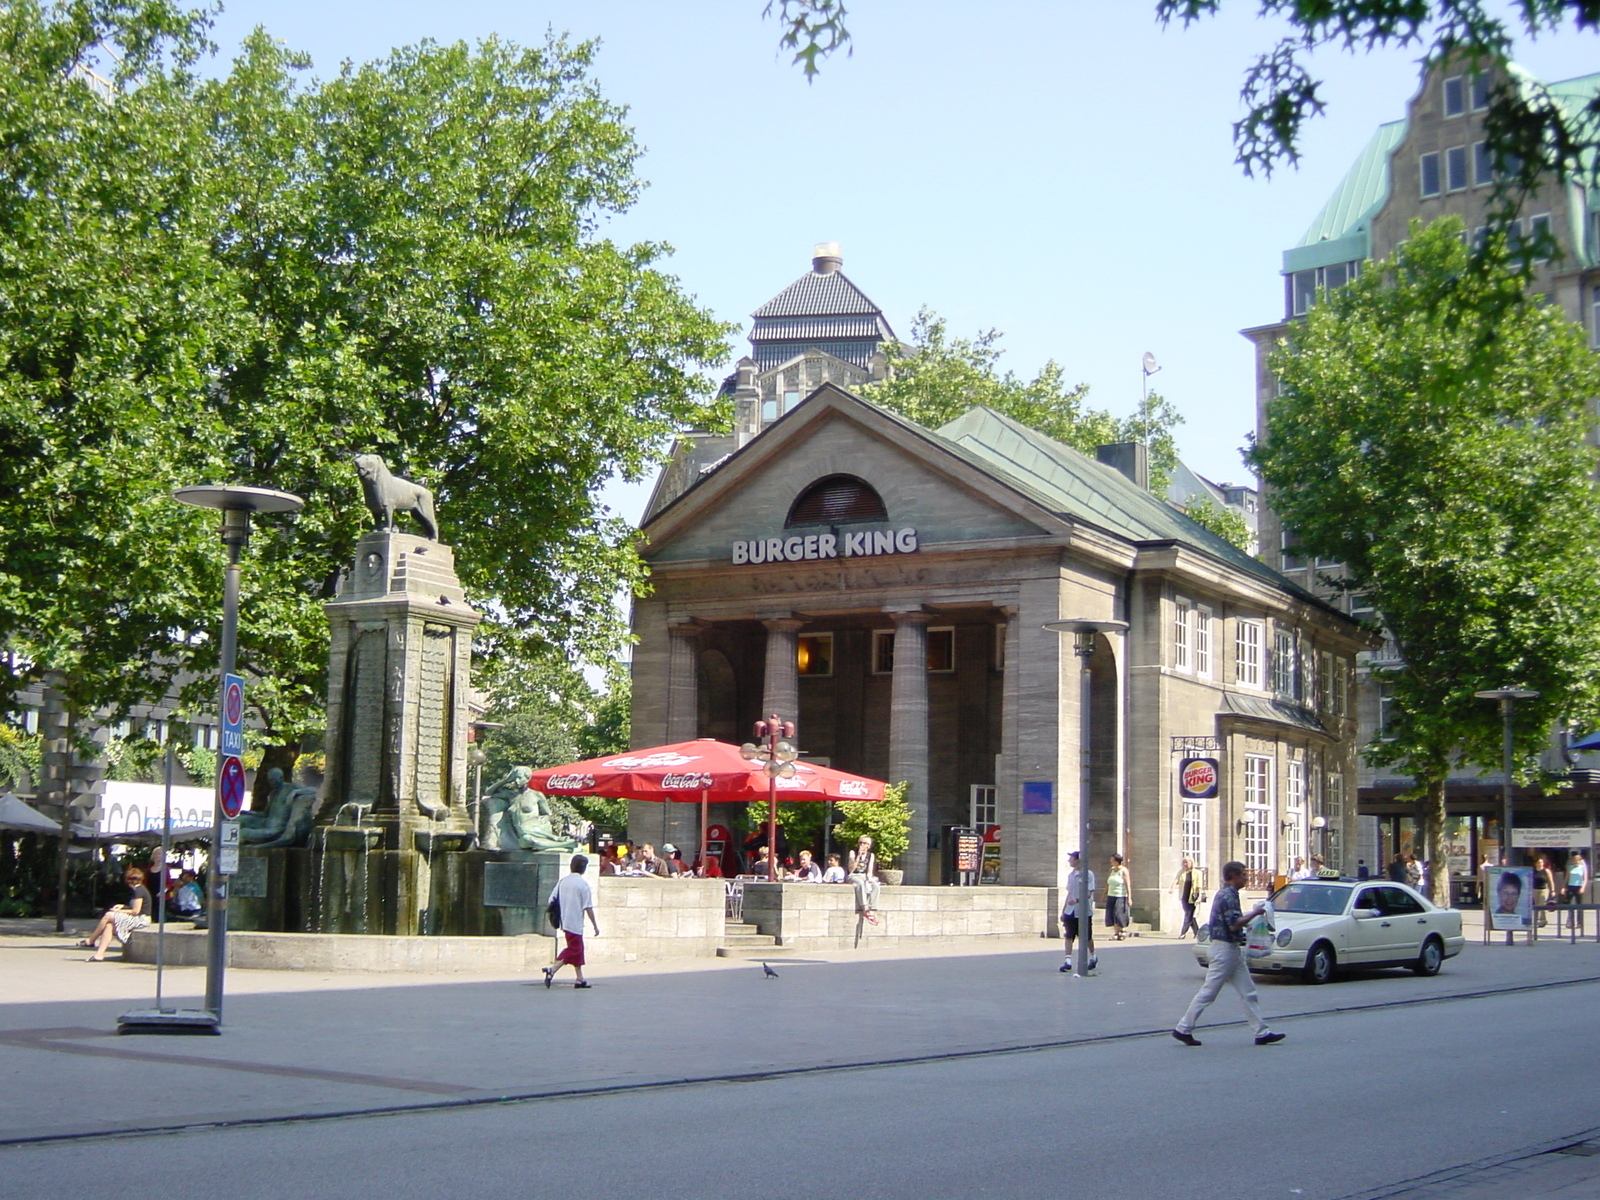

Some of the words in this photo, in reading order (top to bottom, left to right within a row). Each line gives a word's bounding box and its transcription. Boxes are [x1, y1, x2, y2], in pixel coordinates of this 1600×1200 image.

[733, 533, 837, 565] BURGER
[845, 527, 917, 557] KING
[225, 730, 241, 749] TAXI
[1184, 766, 1213, 779] BURGER
[1185, 774, 1214, 789] KING
